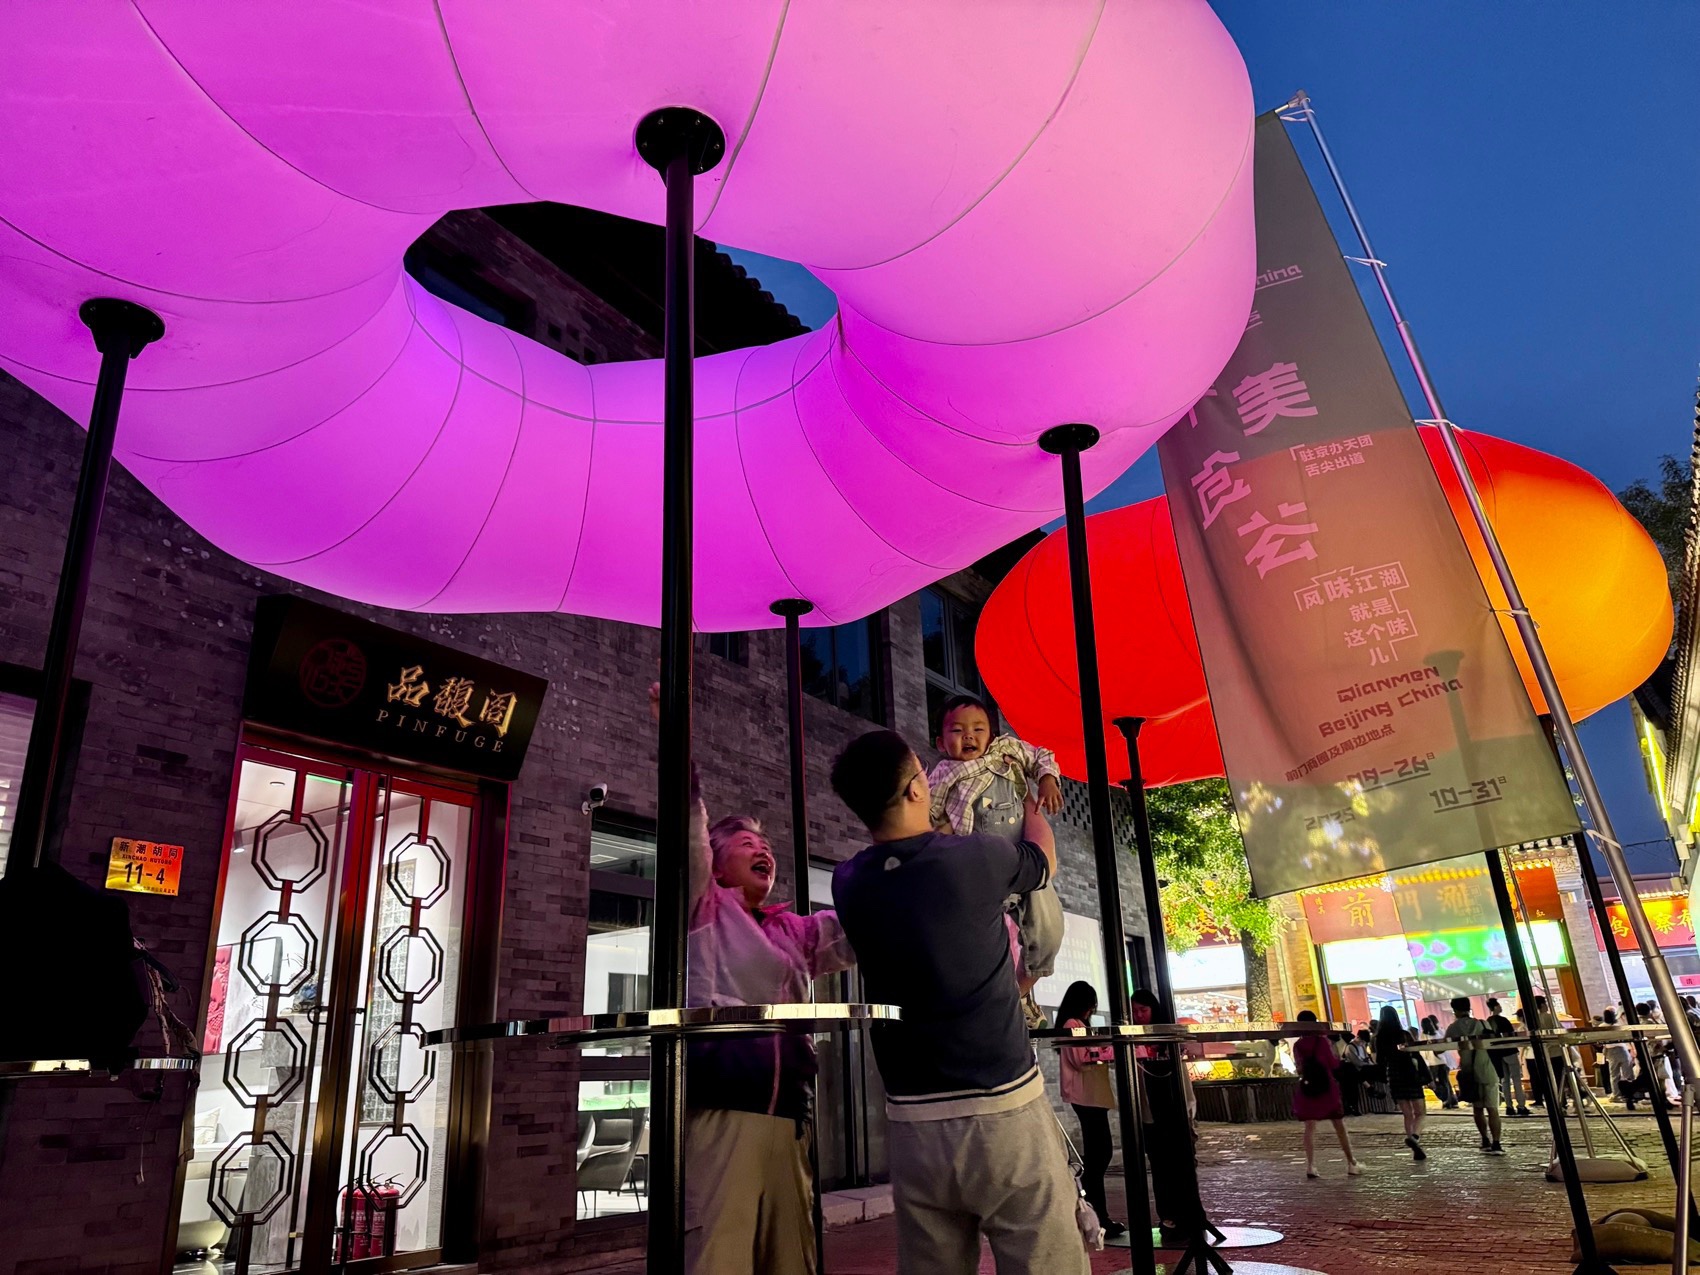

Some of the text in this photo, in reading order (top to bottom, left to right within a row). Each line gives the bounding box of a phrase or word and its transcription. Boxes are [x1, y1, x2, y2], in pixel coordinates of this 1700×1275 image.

[1299, 434, 1373, 462] 驻京办天团
[1305, 452, 1365, 477] 舌尖出道
[1302, 568, 1402, 609] 风味江湖
[1349, 597, 1394, 622] 就是
[1343, 617, 1409, 648] 这个味
[1369, 646, 1390, 666] 儿
[385, 663, 518, 739] 品馥阁
[375, 708, 504, 753] PINFUGE
[1285, 723, 1396, 782] 前门商圈及周边地点
[119, 841, 178, 859] 新潮胡同
[124, 861, 165, 885] 11-4
